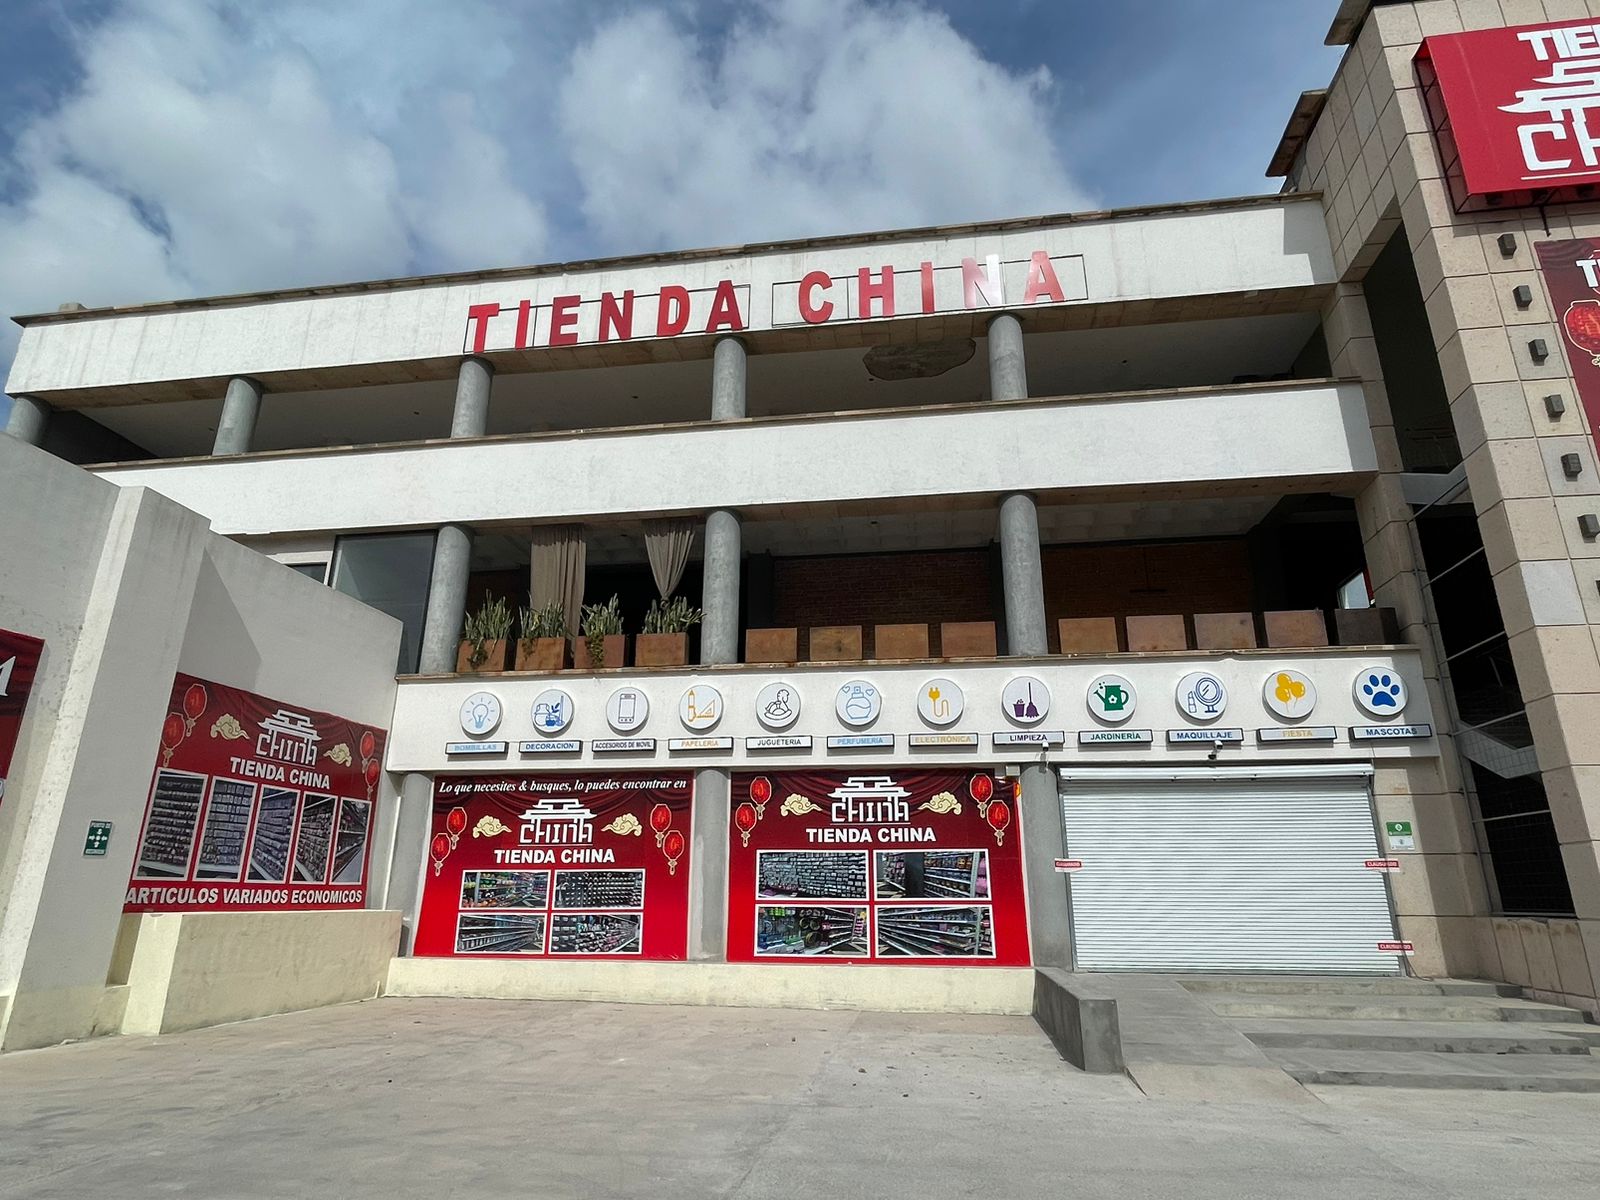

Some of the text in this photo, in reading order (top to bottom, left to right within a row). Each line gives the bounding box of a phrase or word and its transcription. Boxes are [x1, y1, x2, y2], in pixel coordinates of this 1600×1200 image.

[1516, 24, 1600, 61] TIE
[468, 250, 1065, 354] TIENDA CHINA
[1009, 732, 1048, 742] LIMPIEZA
[1176, 730, 1234, 741] MAQUILLAJE
[1282, 730, 1313, 738] FIESTA
[1365, 727, 1418, 736] MASCOTAS
[230, 756, 330, 790] TIENDA CHINA
[439, 778, 687, 796] Lo que necesites & busques, lo puedes encontrar en
[805, 826, 937, 843] TIENDA CHINA
[494, 848, 616, 864] TIENDA CHINA
[125, 887, 363, 904] ARTICULOS VARIADOS ECONOMICOS
